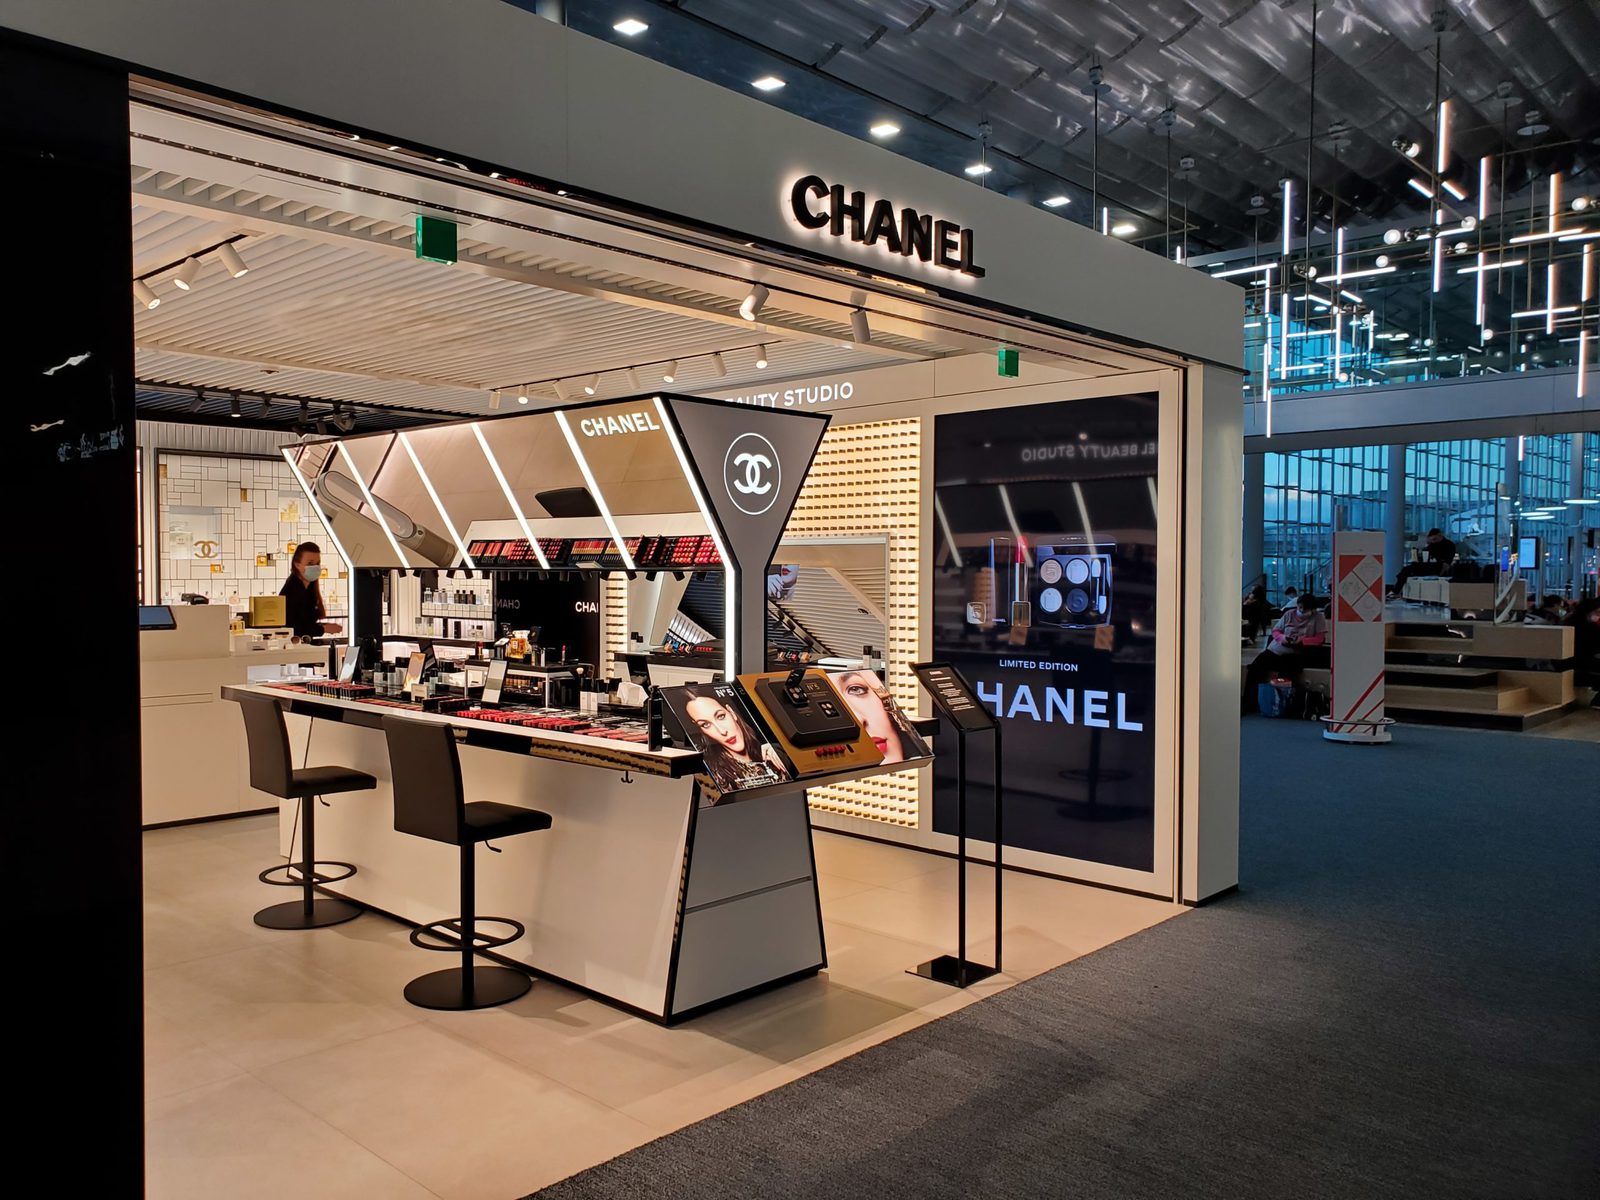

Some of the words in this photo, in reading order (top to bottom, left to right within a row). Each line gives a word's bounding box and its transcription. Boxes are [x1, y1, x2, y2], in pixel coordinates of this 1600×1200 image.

[791, 174, 986, 279] CHANEL
[784, 382, 854, 407] STUDIO
[580, 411, 660, 437] CHANEL
[575, 601, 599, 614] CHA
[999, 659, 1037, 669] LIMITED
[1038, 661, 1079, 672] EDITION
[976, 681, 1144, 732] HANEL
